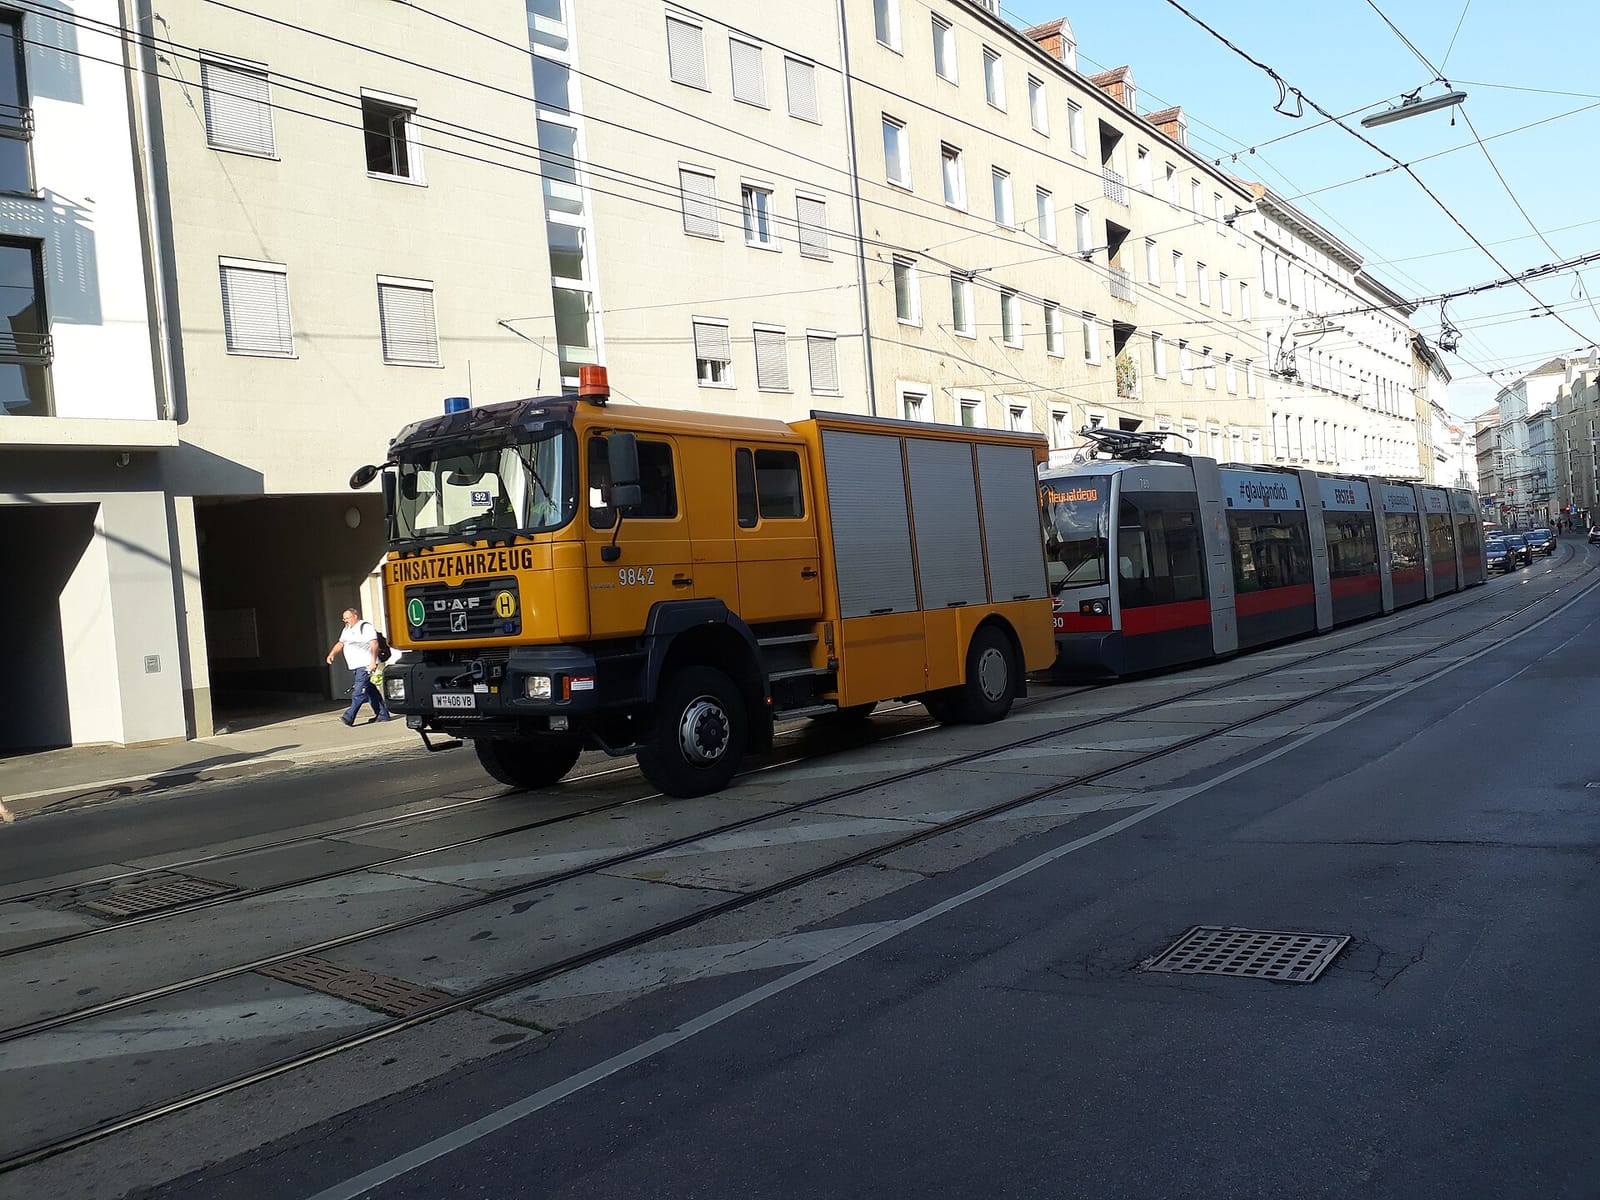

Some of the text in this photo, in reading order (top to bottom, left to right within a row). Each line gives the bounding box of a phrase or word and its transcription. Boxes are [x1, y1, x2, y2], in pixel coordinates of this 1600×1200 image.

[475, 492, 487, 501] 92
[1048, 488, 1098, 503] Neuwaldegg
[1240, 481, 1288, 503] #glaubandich
[393, 548, 532, 583] EINSATZFAHRZEUG
[618, 567, 655, 586] 9842
[411, 604, 421, 621] L
[500, 596, 511, 615] H
